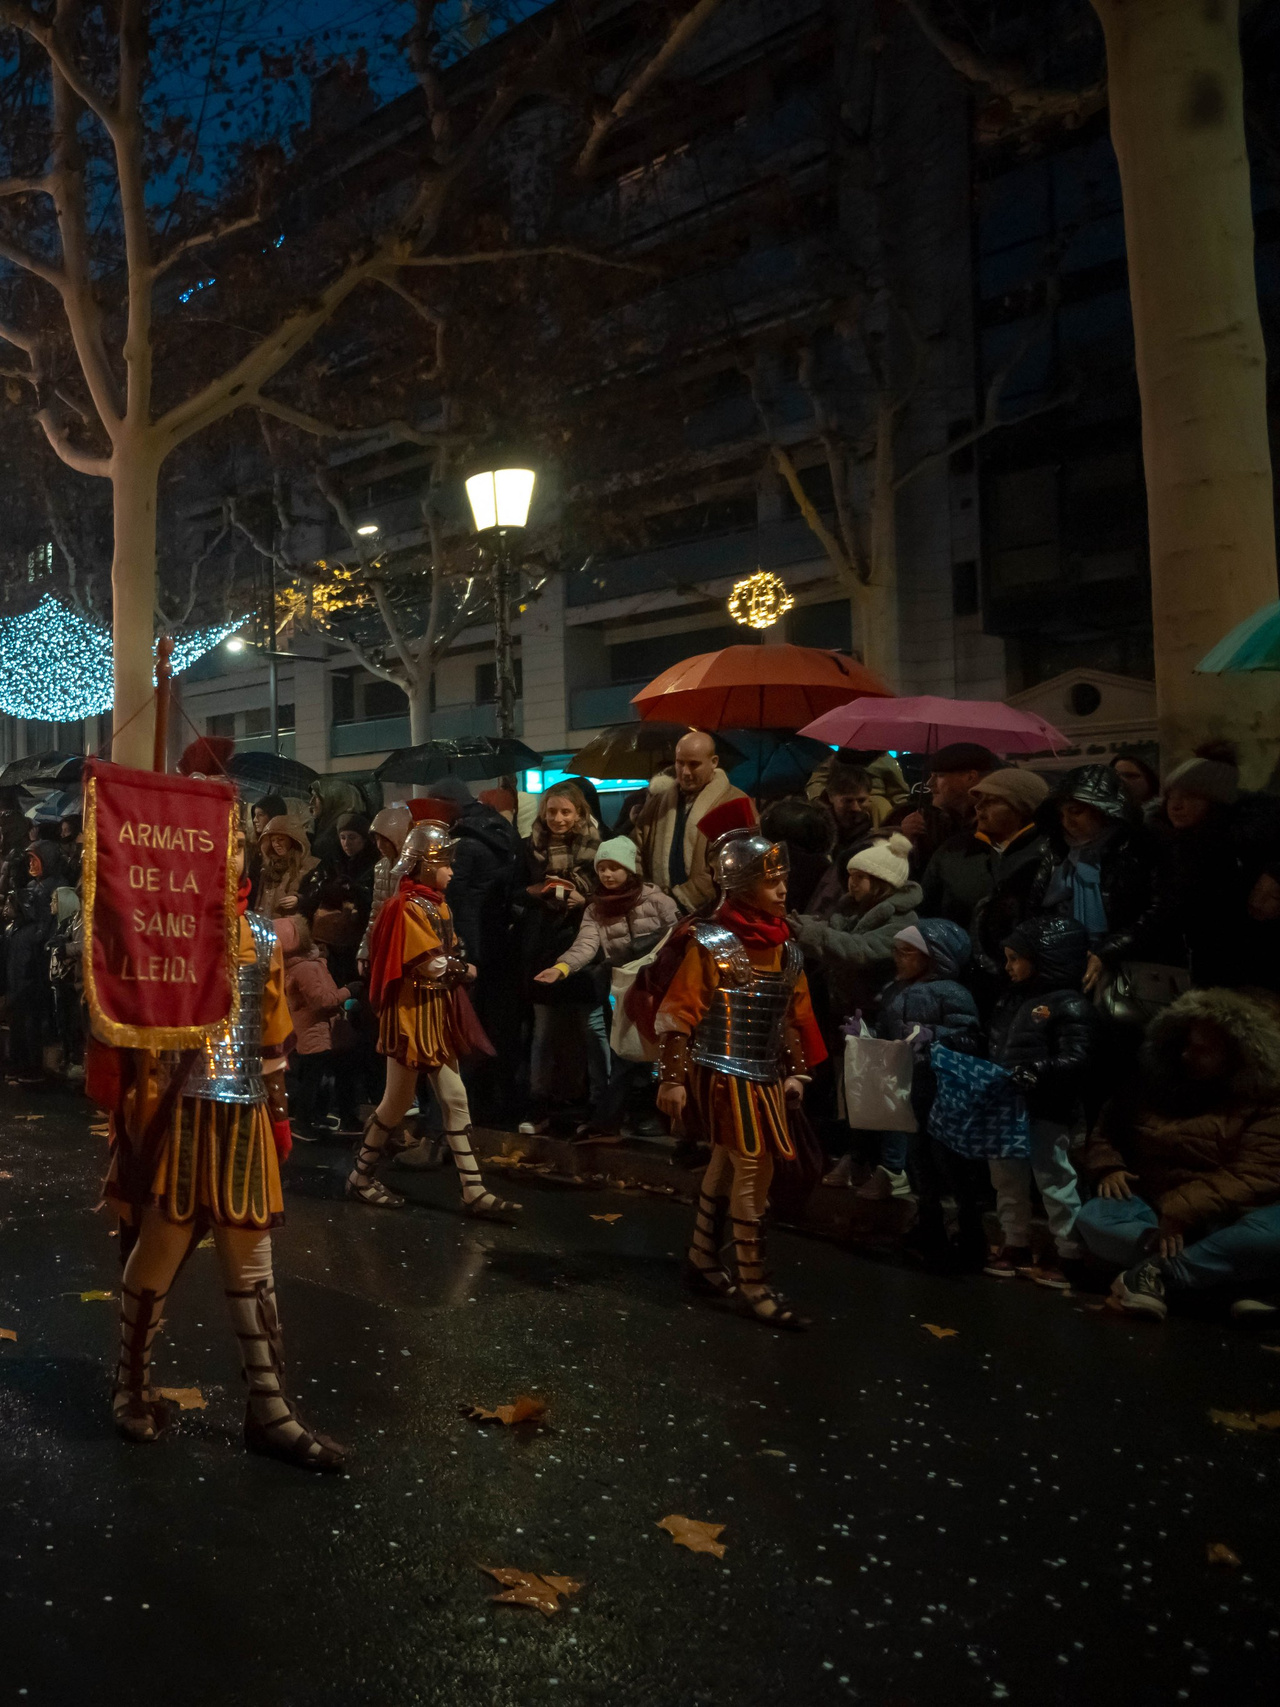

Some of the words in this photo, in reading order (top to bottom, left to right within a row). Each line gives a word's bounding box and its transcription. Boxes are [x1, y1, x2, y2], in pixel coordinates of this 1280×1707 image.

[119, 821, 214, 852] ARMATS
[130, 866, 160, 890] DE
[170, 872, 200, 894] LA
[133, 910, 196, 938] SANG
